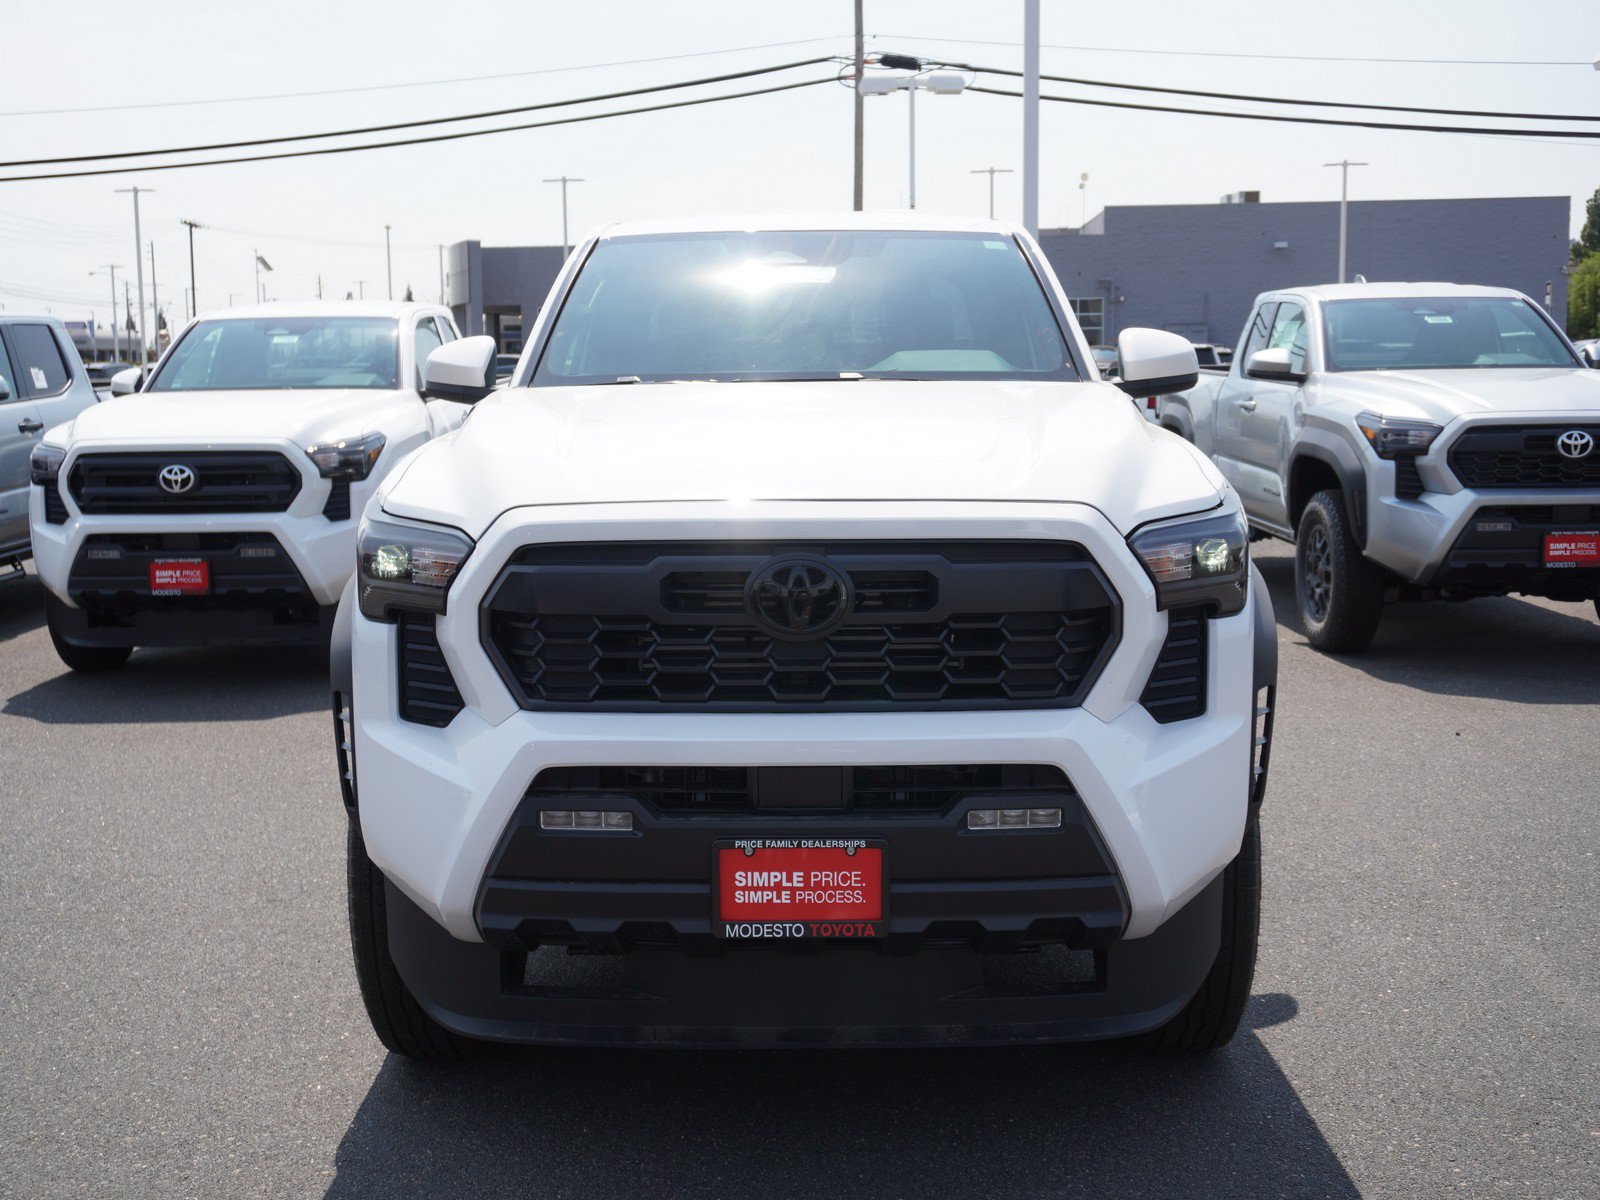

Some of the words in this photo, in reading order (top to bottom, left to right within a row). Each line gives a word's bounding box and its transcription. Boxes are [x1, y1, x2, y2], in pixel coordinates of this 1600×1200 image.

[735, 840, 763, 848] PRICE
[735, 871, 804, 887] SIMPLE
[810, 871, 866, 887] PRICE.
[734, 890, 791, 904] SIMPLE
[796, 890, 866, 904] PROCESS.
[726, 923, 804, 938] MODESTO
[810, 924, 875, 937] TOYOTA
